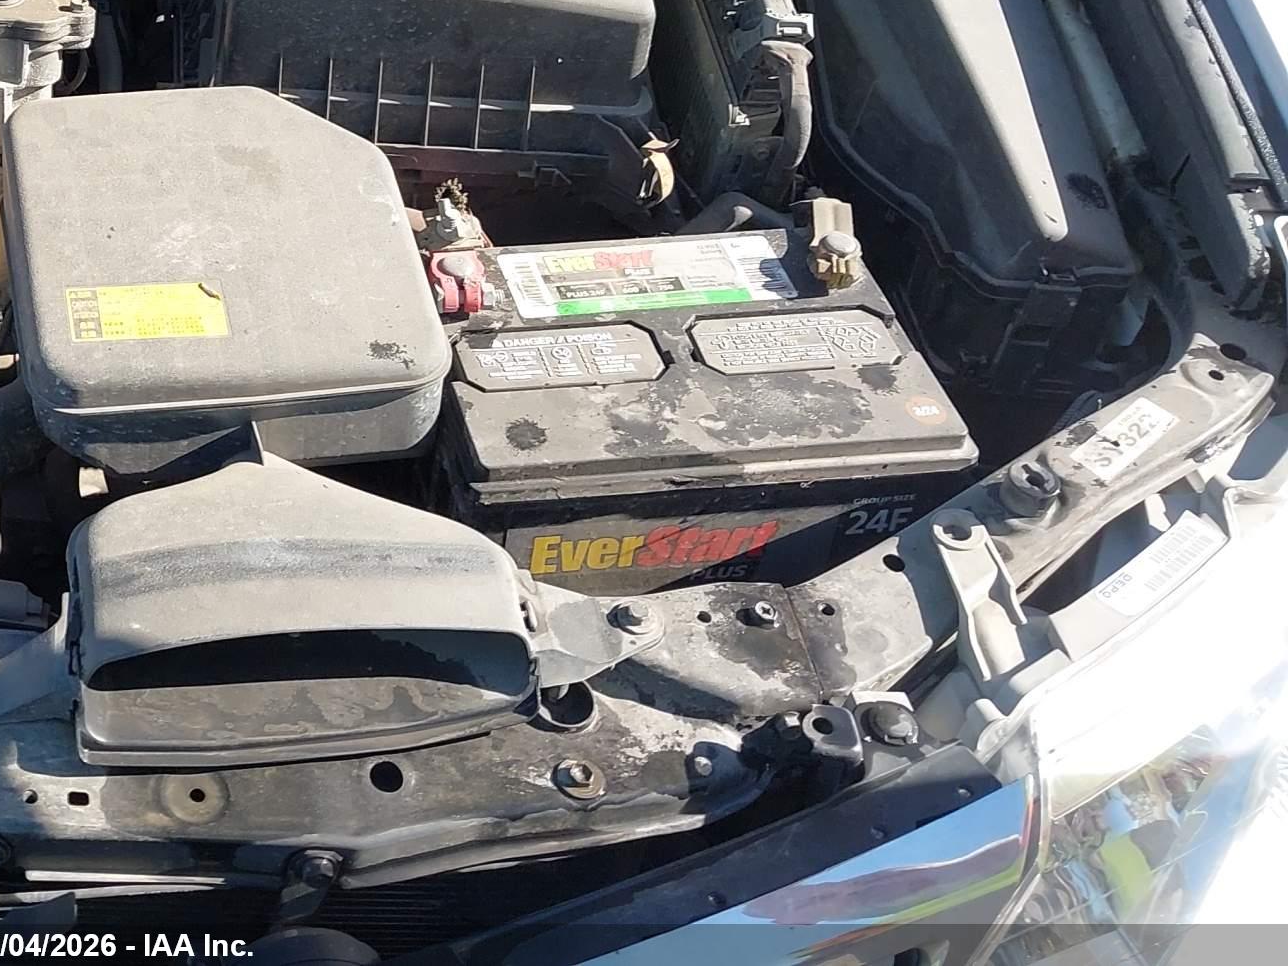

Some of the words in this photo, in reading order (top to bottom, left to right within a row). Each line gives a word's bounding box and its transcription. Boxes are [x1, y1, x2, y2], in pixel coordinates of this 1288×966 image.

[543, 249, 655, 275] EverStart
[503, 336, 556, 347] DANGER
[566, 332, 613, 343] POISON
[853, 496, 891, 506] GROUP
[844, 506, 913, 535] 24F
[529, 520, 779, 577] EverStart
[690, 564, 748, 581] PLUS
[1102, 573, 1133, 599] DEPO
